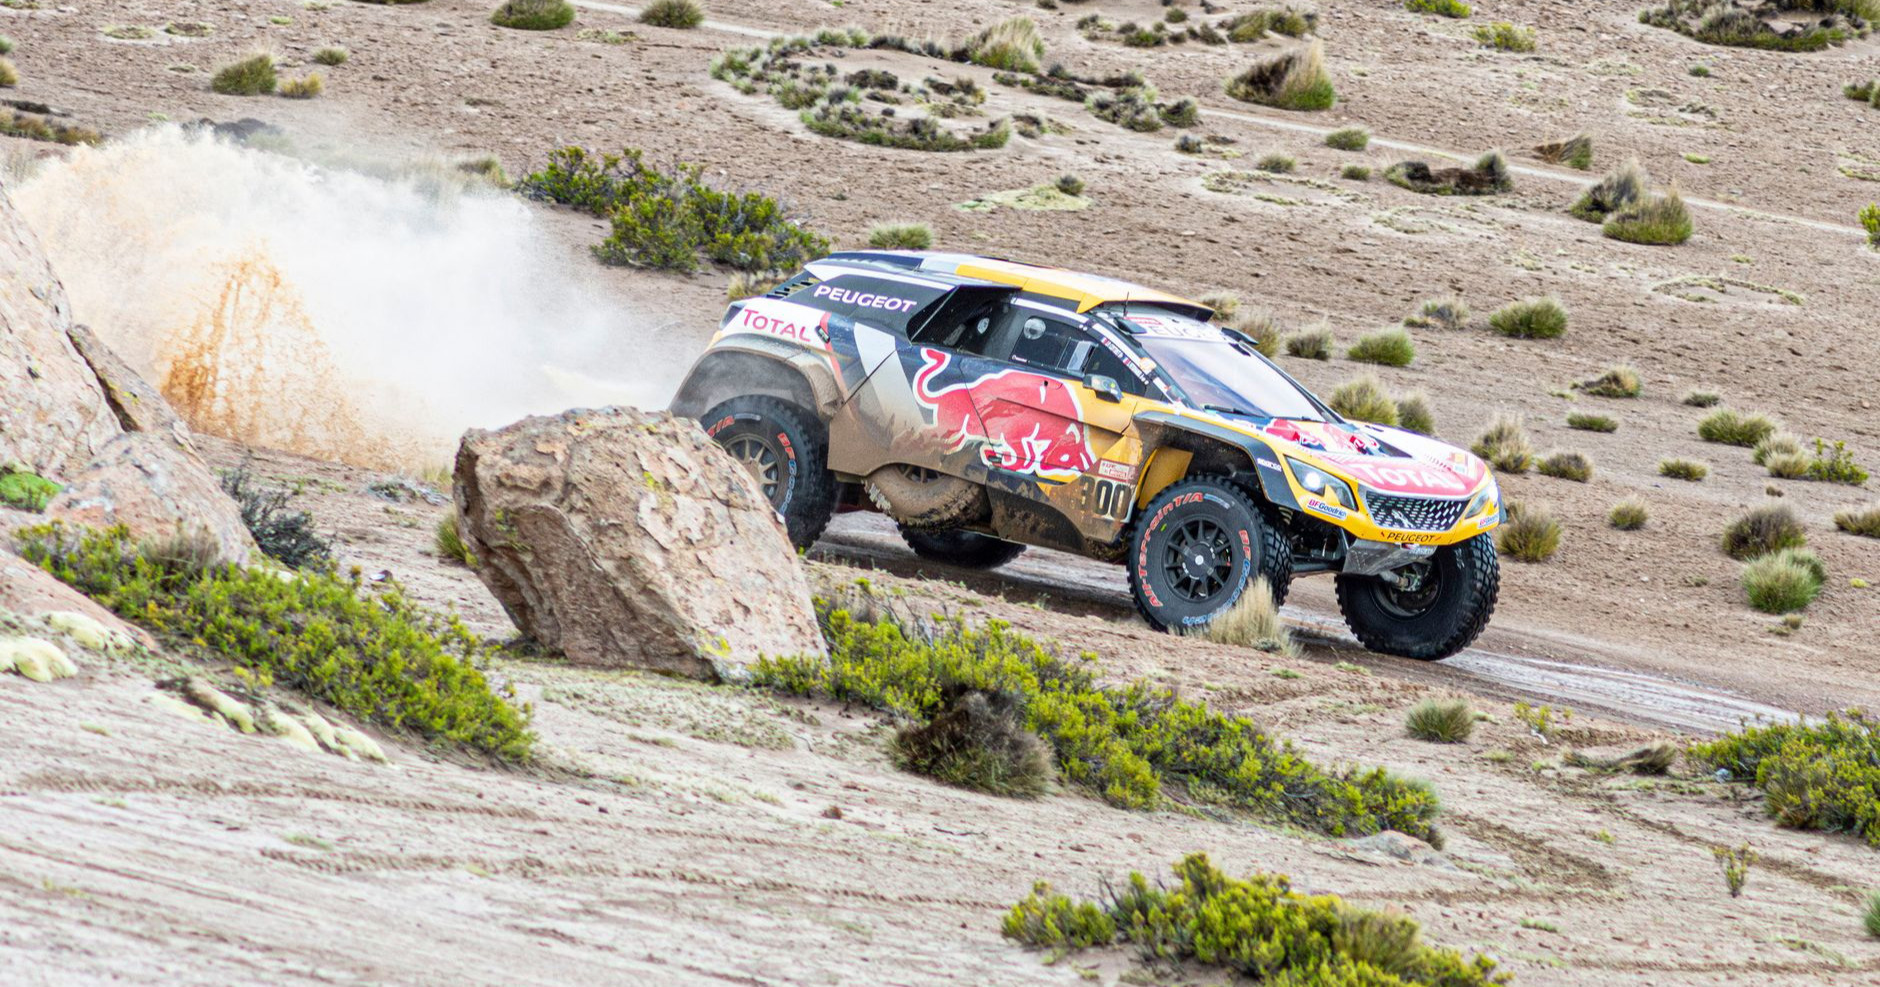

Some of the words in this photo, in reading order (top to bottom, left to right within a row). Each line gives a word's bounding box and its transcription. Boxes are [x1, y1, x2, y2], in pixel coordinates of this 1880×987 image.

[814, 285, 917, 312] PEUGEOT
[744, 309, 811, 342] TOTAL
[1350, 463, 1467, 490] TOTAL
[1077, 476, 1132, 520] 300
[1386, 531, 1437, 543] PEUGEOT
